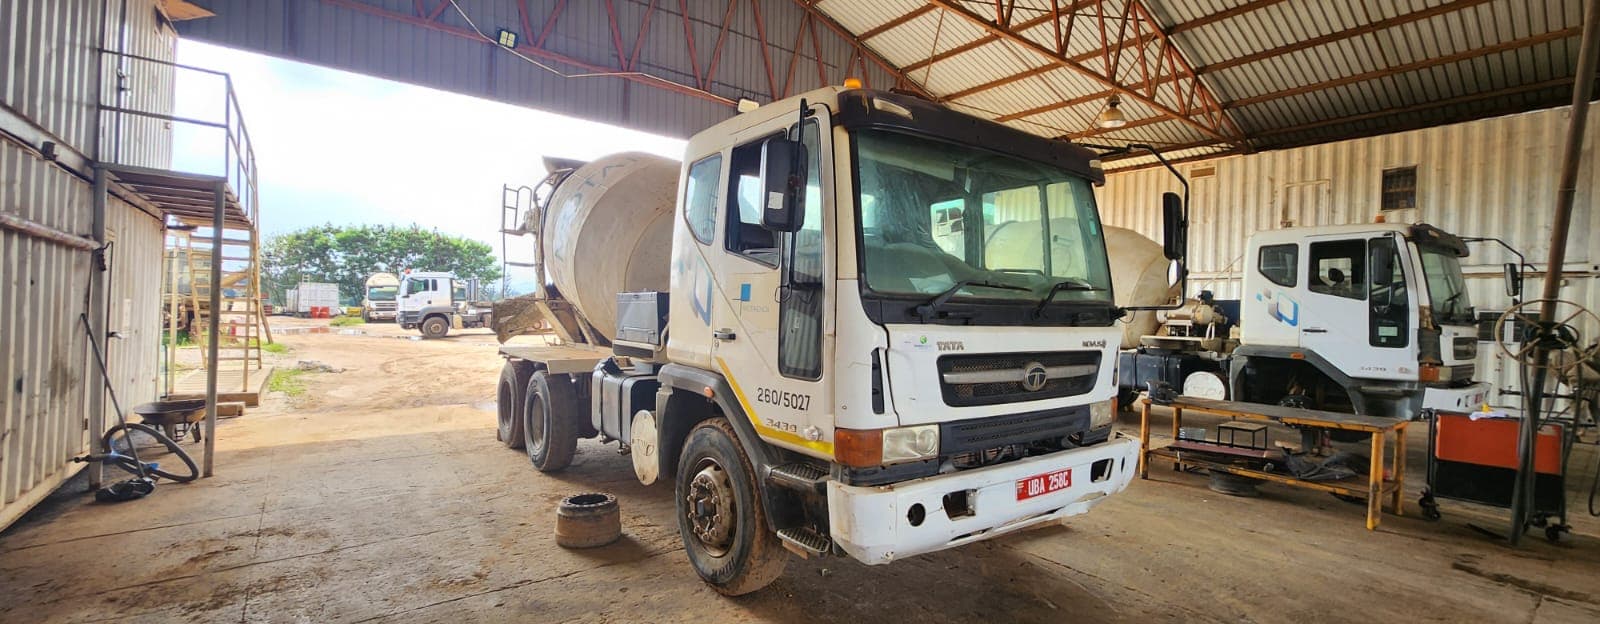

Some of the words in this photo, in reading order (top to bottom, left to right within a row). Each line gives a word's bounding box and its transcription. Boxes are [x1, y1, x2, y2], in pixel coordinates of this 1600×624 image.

[937, 341, 964, 351] TATA
[757, 387, 811, 411] 260/5027
[1028, 477, 1046, 496] UBA
[1048, 471, 1069, 491] 258C
